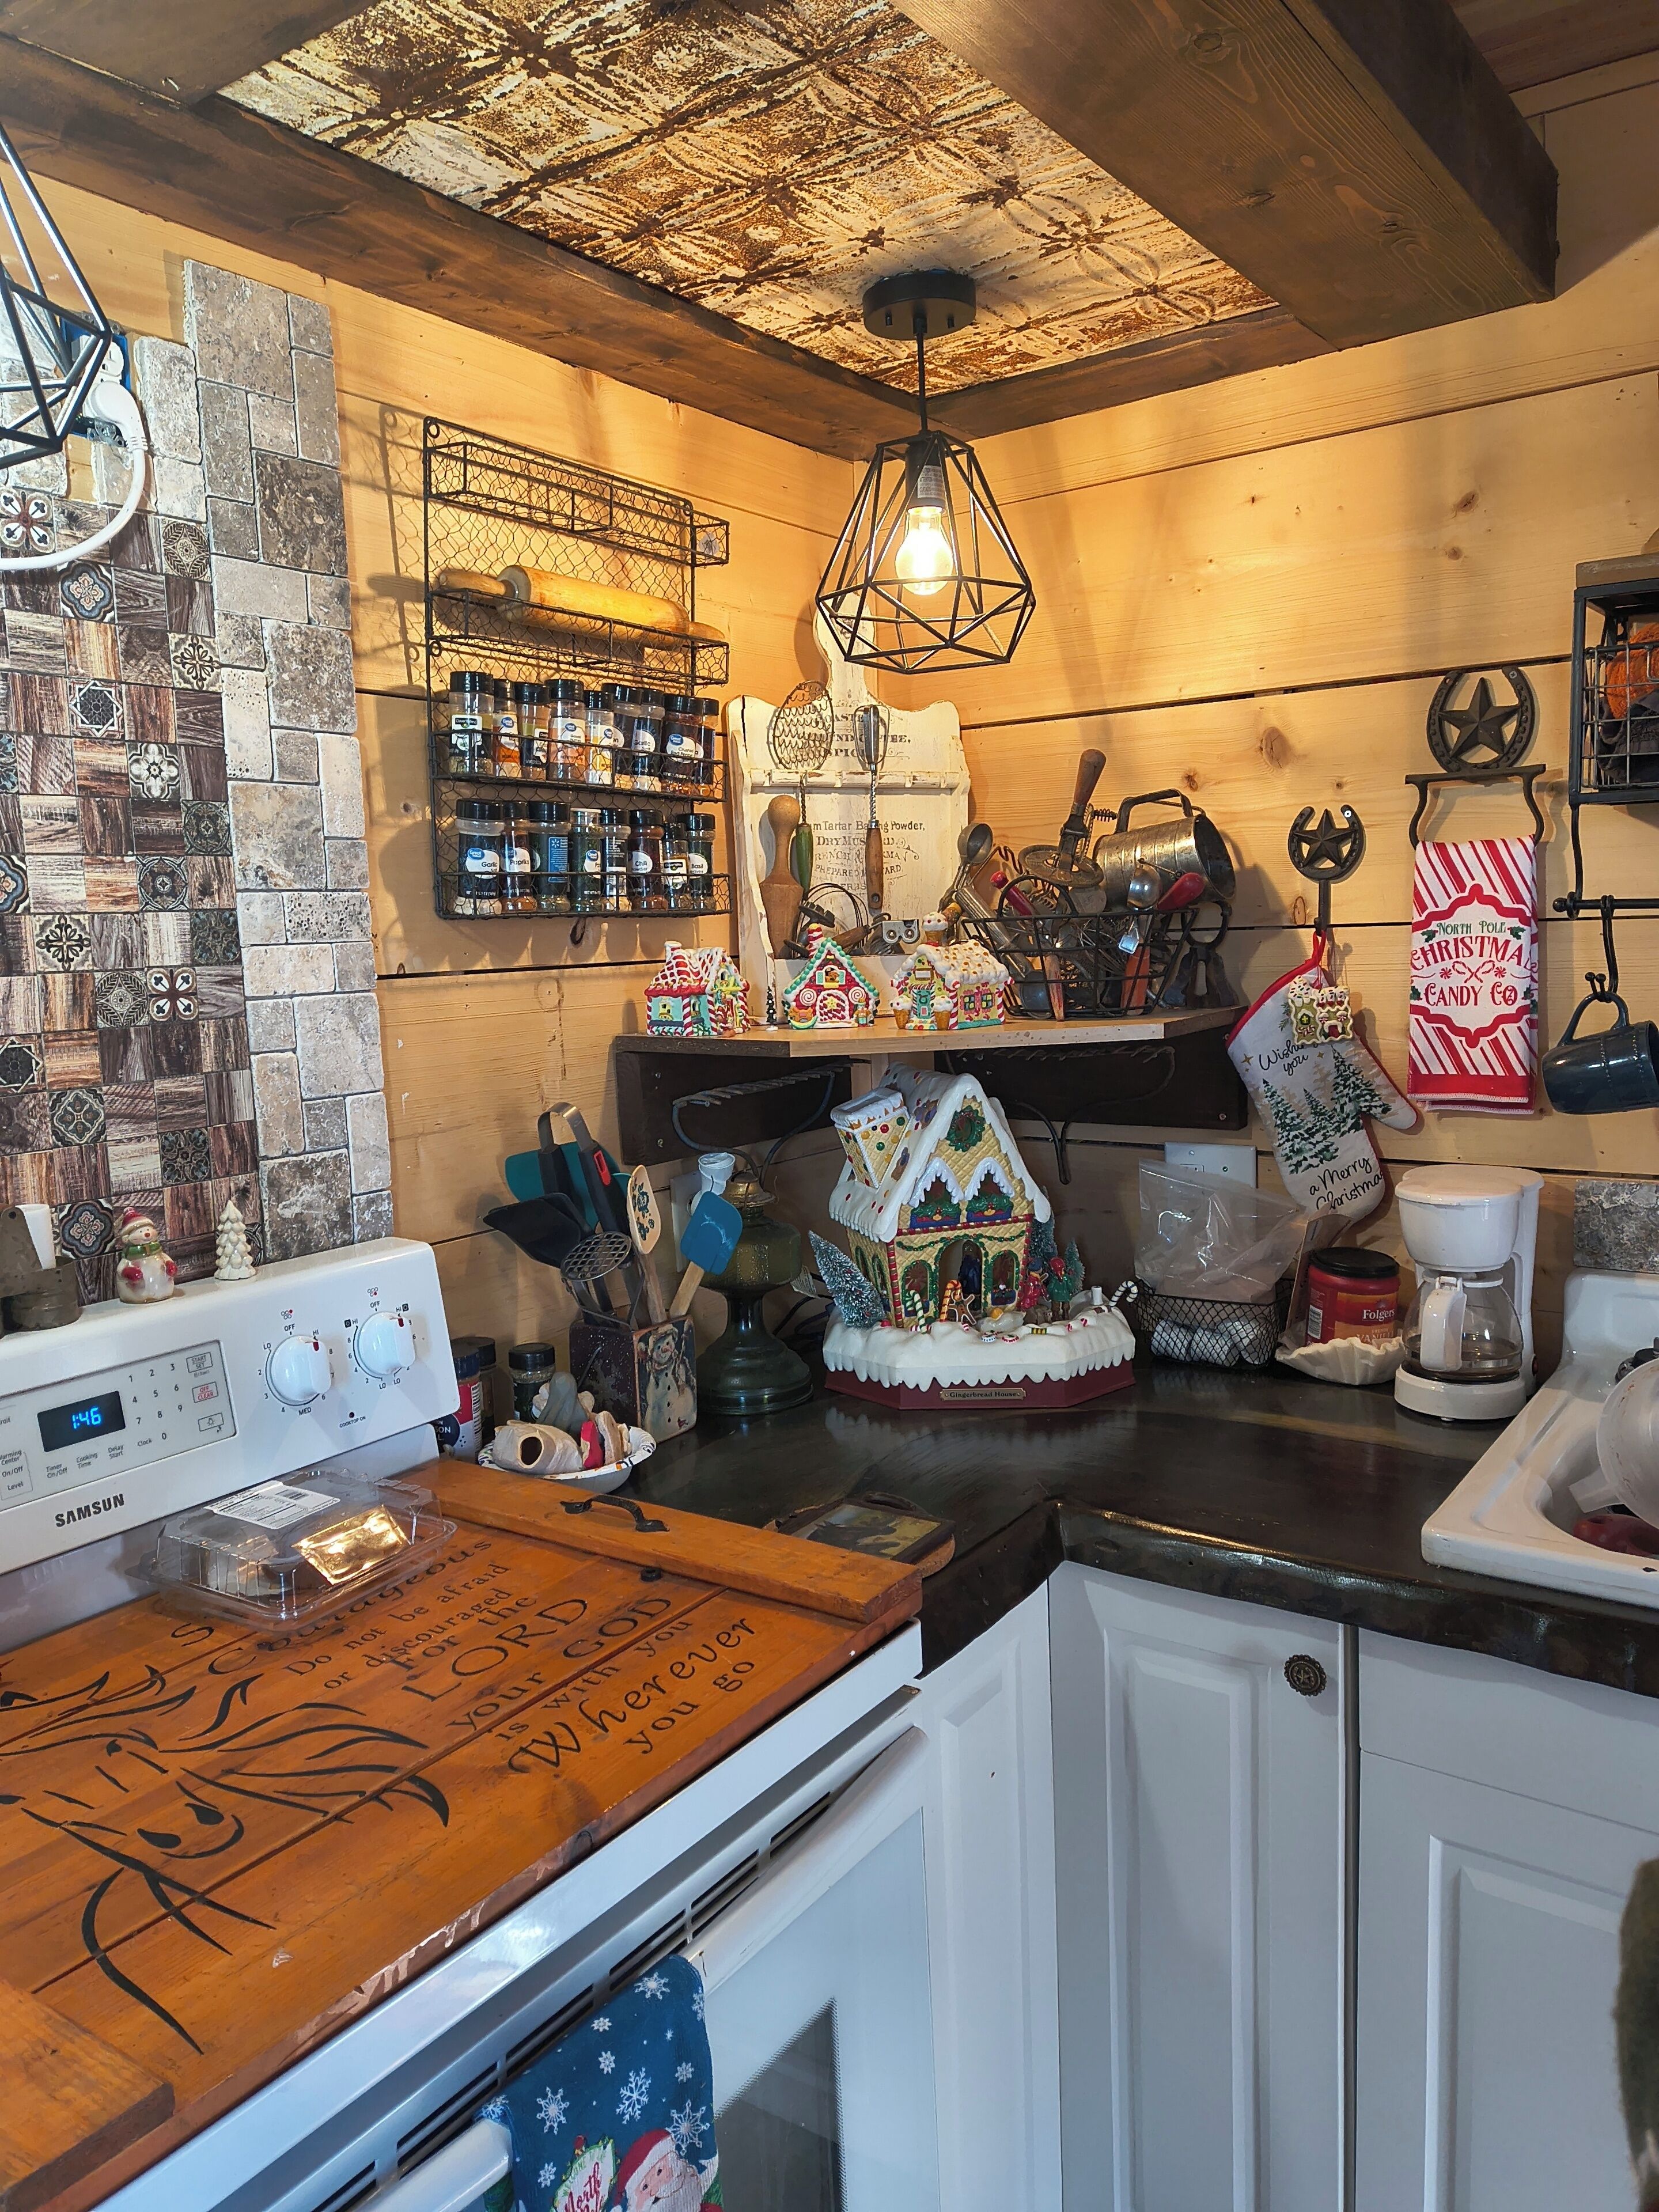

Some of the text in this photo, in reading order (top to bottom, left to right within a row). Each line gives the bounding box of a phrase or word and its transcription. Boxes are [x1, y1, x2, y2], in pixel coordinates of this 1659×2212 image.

[824, 820, 852, 830] Tartar
[891, 820, 926, 831] Powder,
[1437, 921, 1506, 935] NORTH POLE
[1424, 982, 1483, 1006] CANDY
[1283, 1055, 1309, 1076] you
[1309, 1157, 1372, 1195] a Merry
[1316, 1172, 1383, 1210] Christma
[1362, 1308, 1396, 1321] Folgers
[284, 1324, 296, 1332] OFF
[153, 1389, 158, 1398] 5
[174, 1384, 179, 1392] 6
[198, 1392, 214, 1401] CLEAR
[72, 1407, 102, 1429] 1:46
[136, 1404, 183, 1425] 7 8 9
[298, 1407, 312, 1416] MED
[339, 1418, 359, 1427] COOKTOP
[137, 1438, 152, 1447] Clock
[161, 1432, 167, 1441] 0
[108, 1445, 124, 1453] Delay
[108, 1451, 124, 1459] Start
[1, 1456, 20, 1465] Center
[76, 1453, 98, 1463] Cooking
[2, 1465, 24, 1478] On/Off
[46, 1464, 62, 1472] Timer
[47, 1467, 67, 1479] On/Off
[7, 1480, 24, 1491] Level
[284, 1562, 512, 1676] Do not be afraid
[324, 1588, 513, 1690] or discouraged
[388, 1595, 539, 1672] For the
[402, 1599, 588, 1703] LORD
[445, 1598, 672, 1732] your GOD
[495, 1620, 694, 1741] is with you
[507, 1618, 756, 1774] Wherever
[623, 1661, 755, 1755] you go
